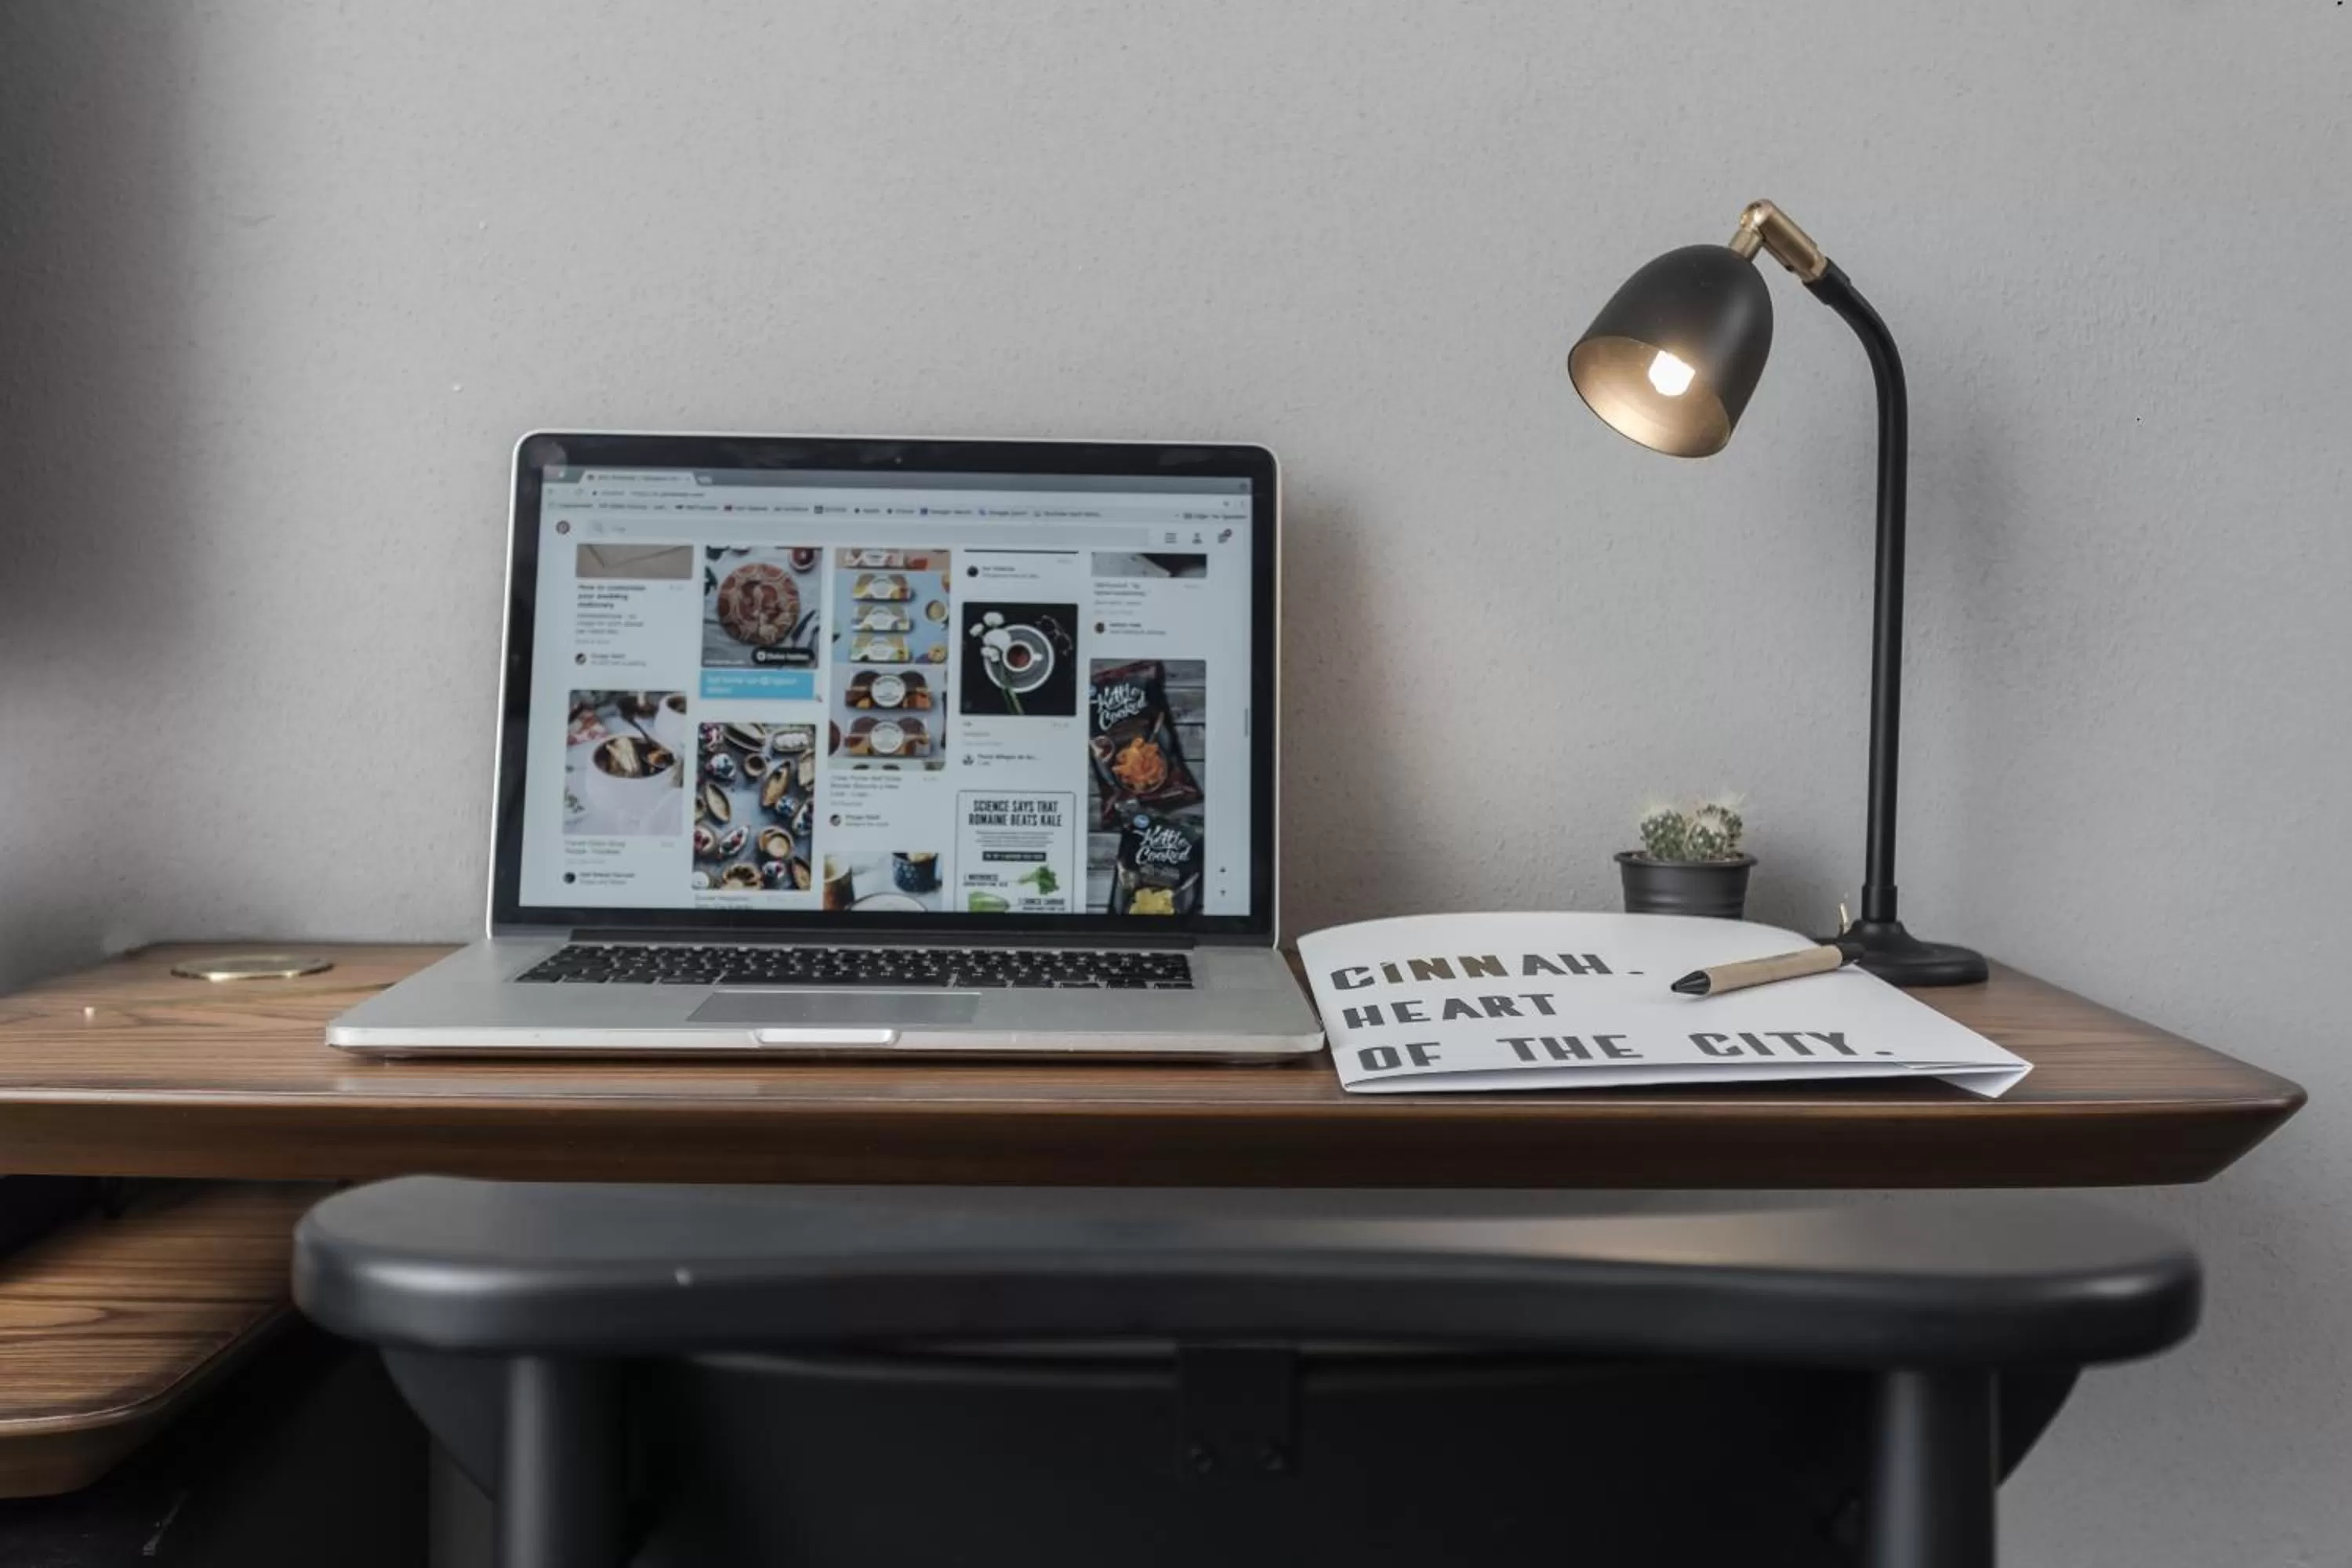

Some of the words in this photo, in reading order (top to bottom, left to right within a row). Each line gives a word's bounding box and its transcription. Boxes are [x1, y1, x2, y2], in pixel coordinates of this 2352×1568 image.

[973, 799, 1009, 812] SCIENCE
[1012, 800, 1035, 813] SAYS
[1037, 800, 1058, 813] THAT
[968, 813, 1007, 826] ROMAINE
[1010, 814, 1038, 826] BEATS
[1040, 814, 1062, 827] KALE
[1342, 993, 1557, 1029] HEART
[1357, 1042, 1441, 1072] OF
[1496, 1034, 1644, 1062] THE
